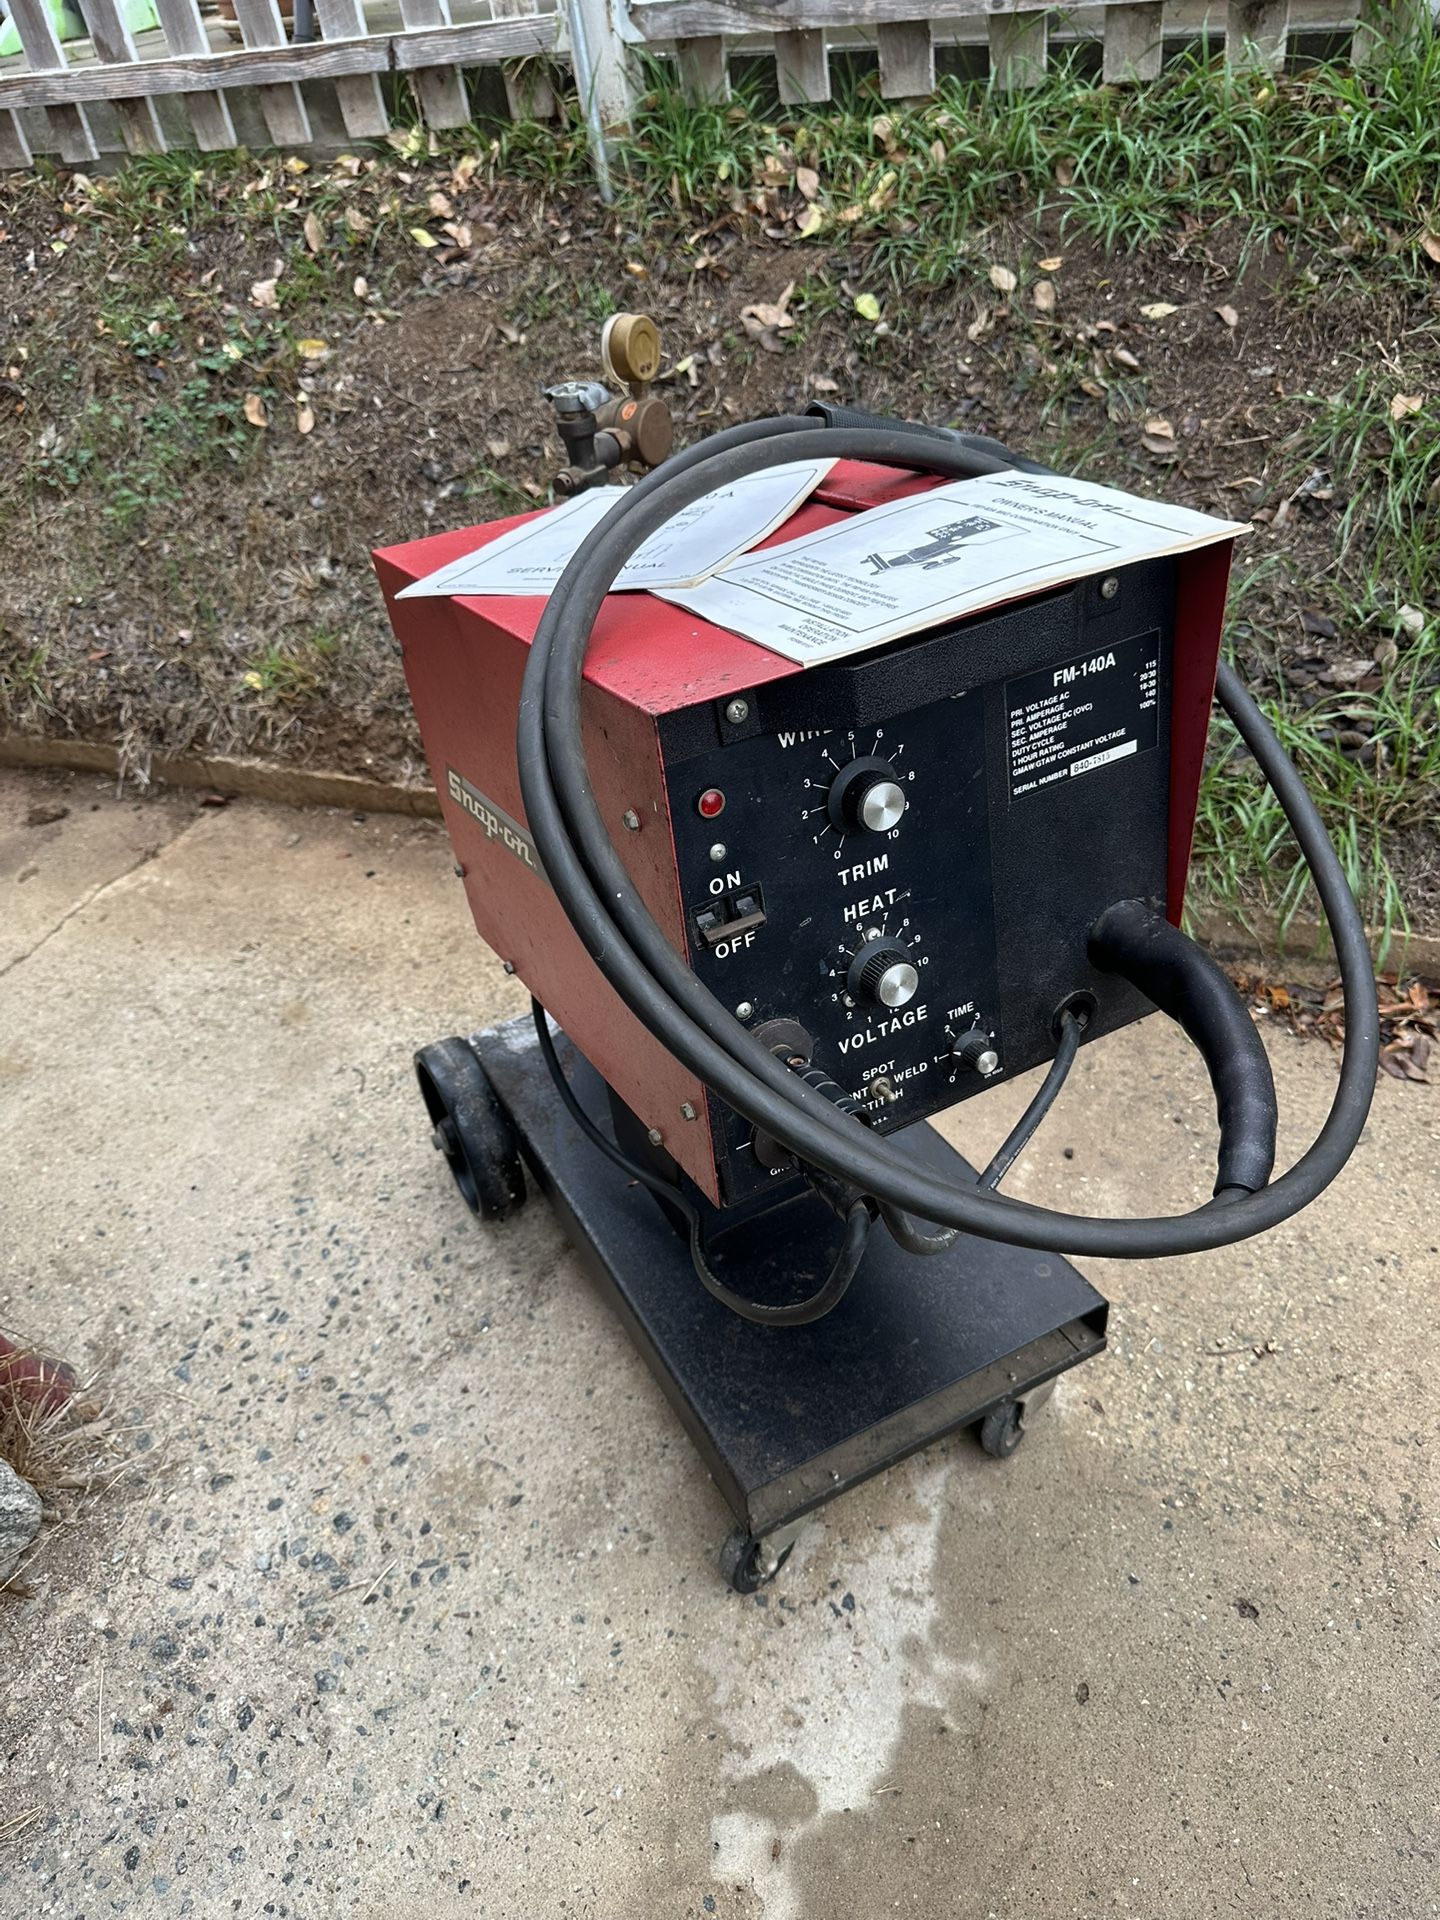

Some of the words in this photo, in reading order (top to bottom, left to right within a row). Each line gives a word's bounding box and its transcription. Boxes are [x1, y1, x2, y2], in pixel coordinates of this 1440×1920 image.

[1044, 512, 1098, 530] MANUAL
[778, 624, 828, 646] MAINTENANCE
[798, 624, 840, 642] OPERATION
[802, 618, 849, 638] INSTALLATION
[1054, 652, 1116, 686] FM-140A
[1145, 660, 1156, 669] 115
[1145, 689, 1156, 698] 140
[1010, 709, 1024, 718] PRI.
[1026, 697, 1058, 714] VOLTAGE
[1059, 692, 1070, 701] AC
[1140, 699, 1156, 710] 100%
[1010, 720, 1024, 728] PRI.
[1026, 703, 1064, 722] AMPERAGE
[1011, 728, 1027, 738] SEC.
[1029, 714, 1061, 732] VOLTAGE
[1062, 710, 1072, 720] DC
[1073, 703, 1093, 717] (OVC)
[778, 730, 833, 748] WIR
[848, 731, 855, 741] 5
[876, 729, 883, 738] 6
[1012, 738, 1028, 748] SEC.
[1029, 722, 1068, 742] AMPERAGE
[898, 744, 904, 754] 7
[1012, 746, 1030, 758] DUTY
[1032, 736, 1055, 750] CYCLE
[1058, 740, 1093, 760] CONSTANT
[1094, 728, 1126, 745] VOLTAGE
[821, 749, 828, 758] 4
[1018, 753, 1038, 765] HOUR
[1040, 742, 1065, 756] RATING
[804, 779, 811, 788] 3
[908, 771, 915, 781] 8
[1013, 781, 1038, 795] SERIAL
[1039, 769, 1068, 785] NUMBER
[802, 810, 808, 820] 2
[812, 836, 818, 844] 1
[887, 829, 899, 840] 10
[834, 850, 841, 860] 0
[838, 854, 888, 885] TRIM
[709, 870, 741, 895] ON
[844, 889, 897, 922] HEAT
[883, 912, 889, 921] 7
[903, 918, 909, 926] 8
[856, 923, 863, 931] 6
[715, 931, 756, 959] OFF
[914, 934, 921, 943] 9
[917, 957, 929, 967] 10
[947, 1001, 974, 1020] TIME
[838, 1004, 928, 1054] VOLTAGE
[944, 1024, 950, 1033] 2
[862, 1060, 895, 1081] SPOT
[894, 1062, 928, 1083] WELD
[850, 1087, 869, 1100] NT
[862, 1088, 904, 1110] TITH
